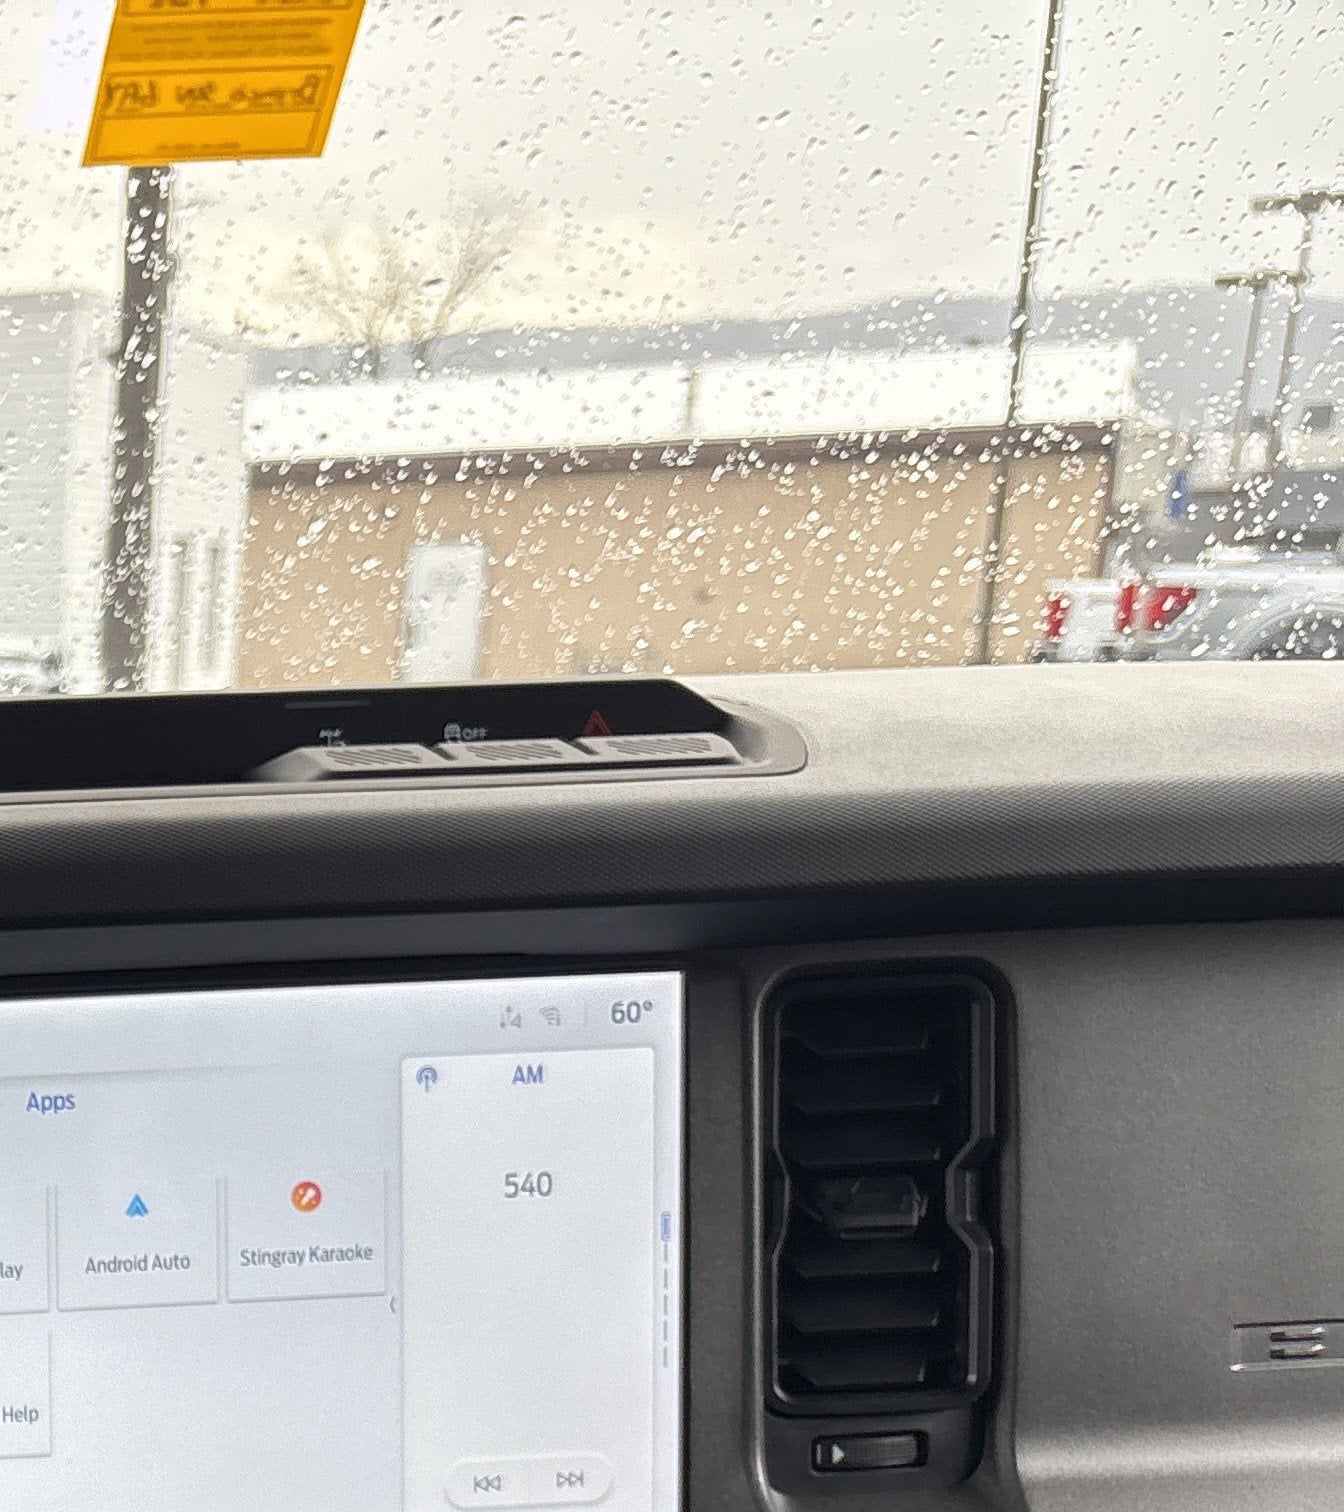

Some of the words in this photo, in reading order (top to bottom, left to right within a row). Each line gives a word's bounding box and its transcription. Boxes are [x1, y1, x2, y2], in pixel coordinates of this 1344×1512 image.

[512, 1063, 544, 1085] AM
[26, 1091, 76, 1116] Apps
[504, 1170, 553, 1199] 540
[85, 1254, 148, 1275] Android
[151, 1254, 191, 1272] Auto
[240, 1248, 305, 1269] Stingray
[308, 1243, 374, 1264] Karaoke
[2, 1406, 40, 1426] Help
